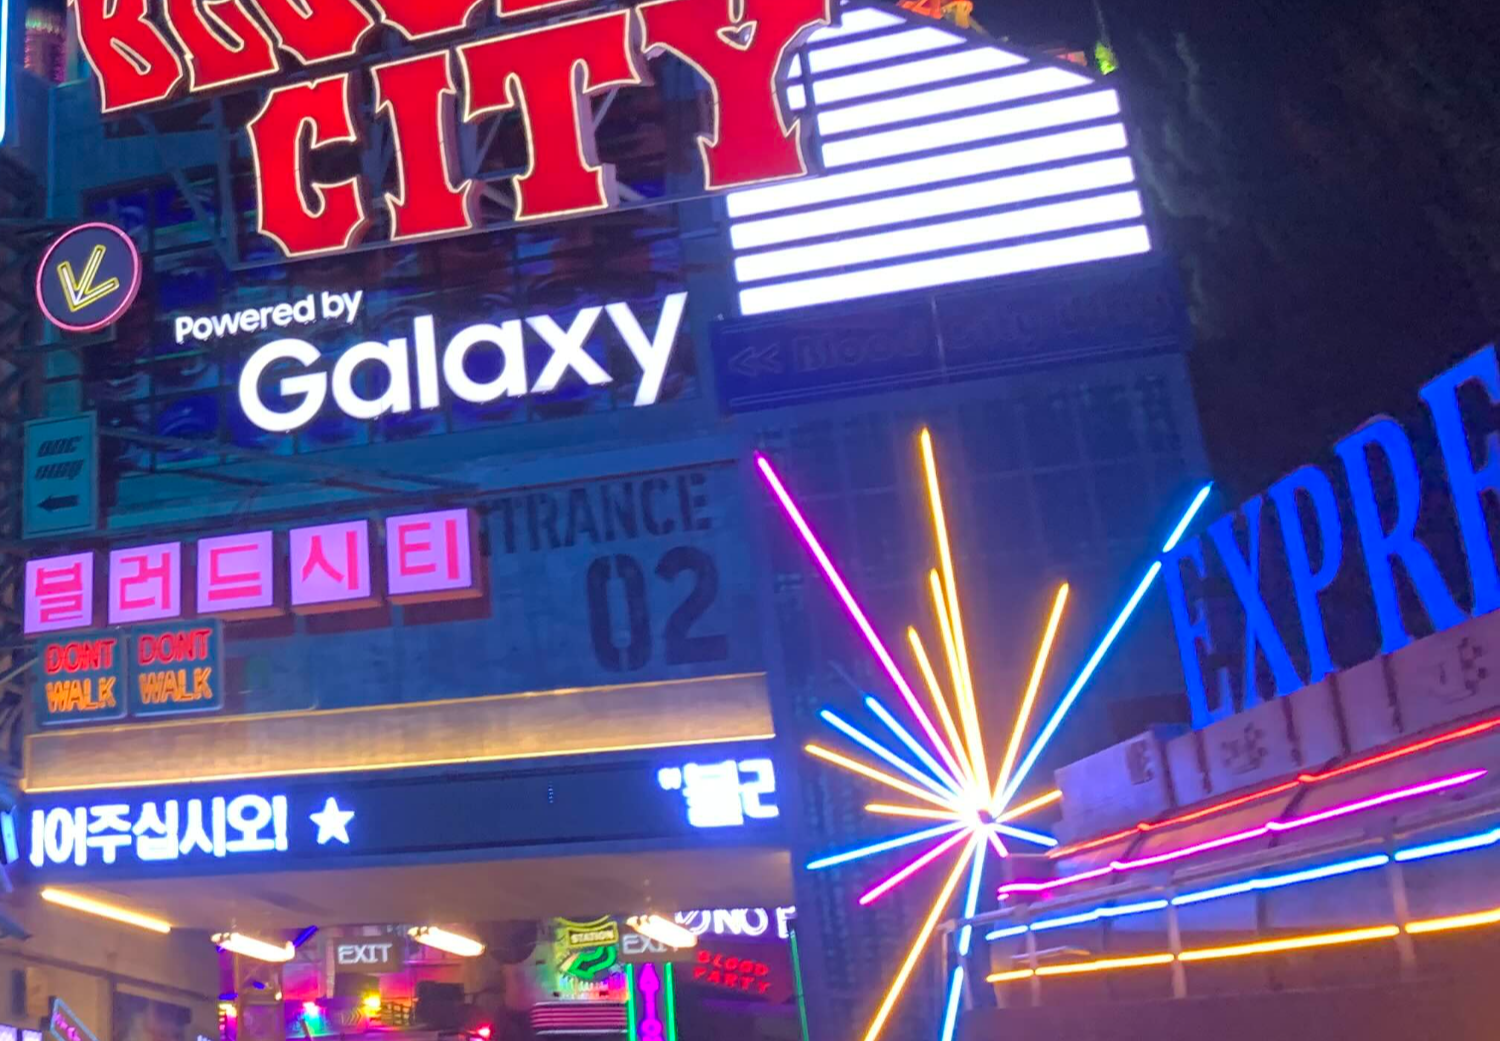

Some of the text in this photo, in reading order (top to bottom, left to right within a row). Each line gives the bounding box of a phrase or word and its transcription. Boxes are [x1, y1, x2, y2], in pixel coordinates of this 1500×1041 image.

[174, 289, 364, 345] Powered by
[238, 291, 688, 433] Galaxy
[34, 519, 462, 623] 블러드시티
[586, 545, 729, 672] 02
[44, 638, 118, 675] DONT
[138, 628, 213, 665] DONT
[44, 676, 116, 713] WALK
[138, 666, 213, 704] WALK
[337, 942, 393, 965] EXIT
[695, 950, 769, 977] BLOOD
[692, 966, 771, 994] PARTY
